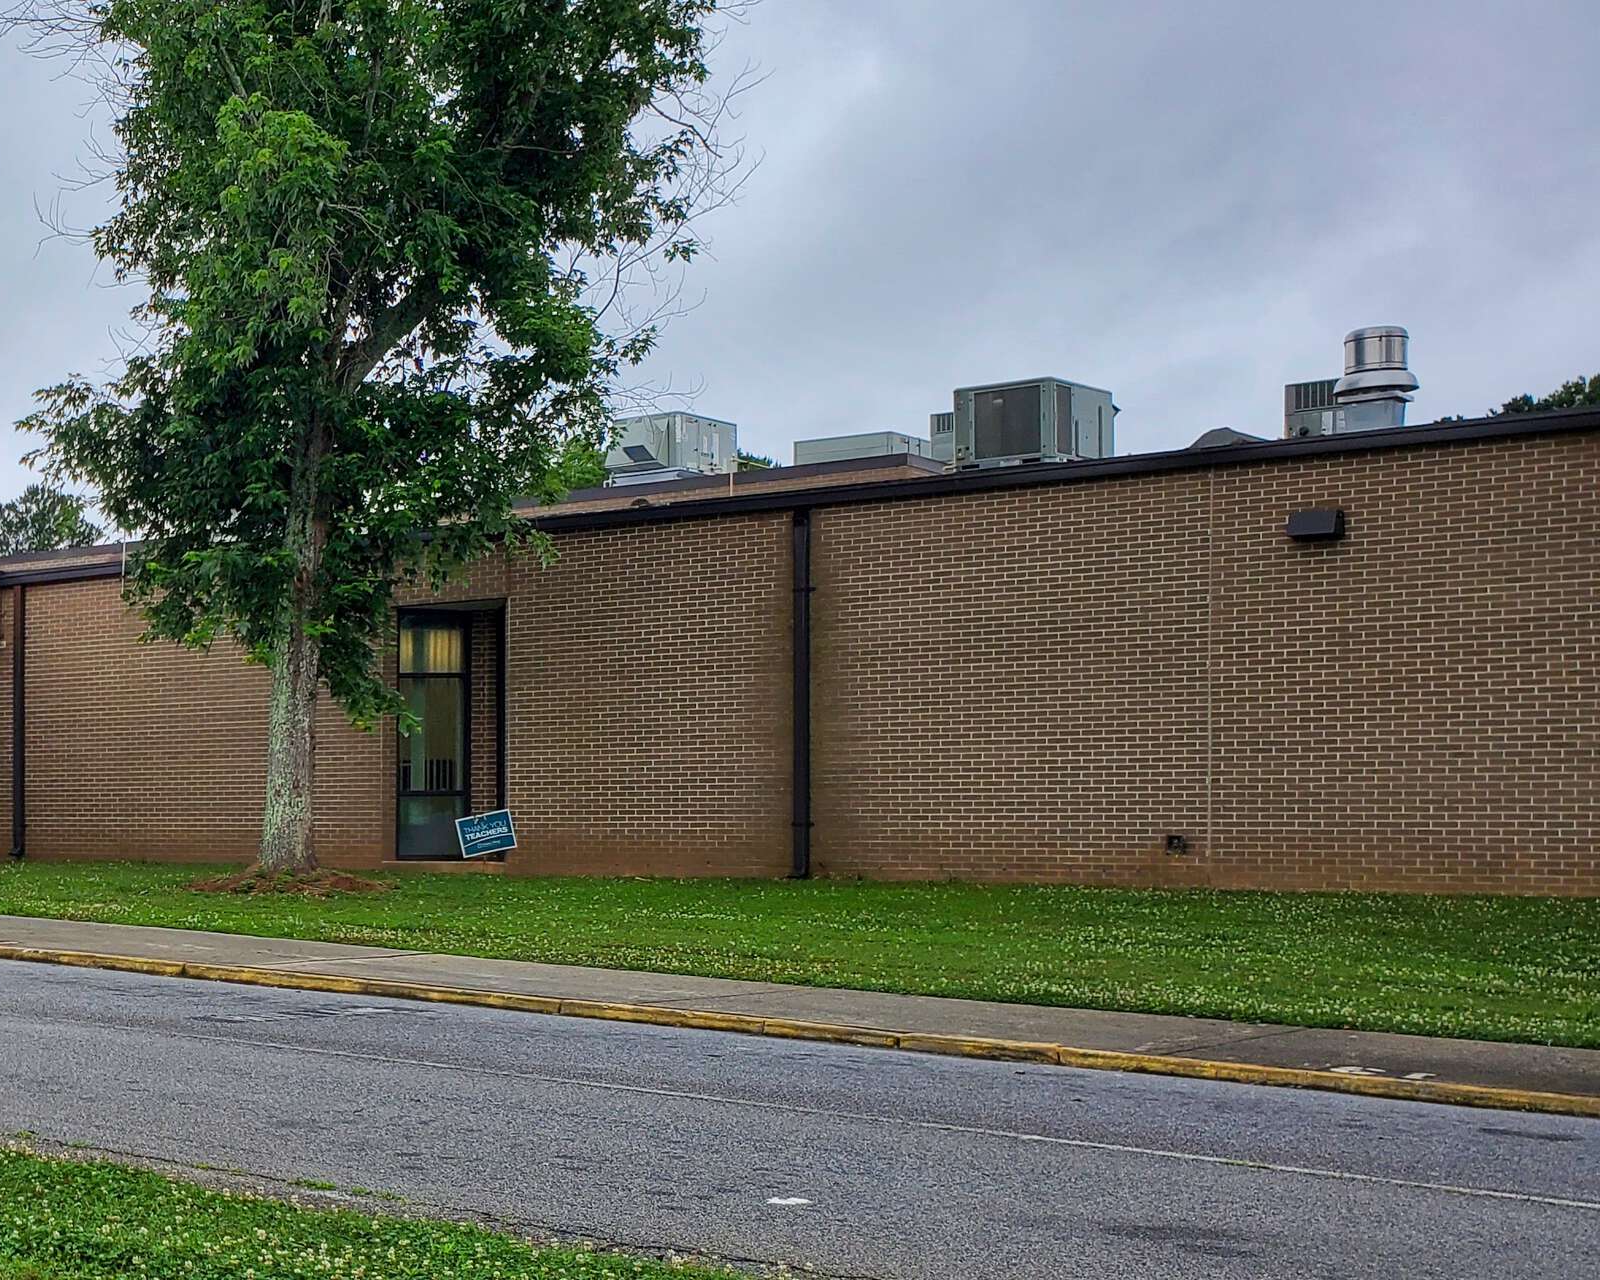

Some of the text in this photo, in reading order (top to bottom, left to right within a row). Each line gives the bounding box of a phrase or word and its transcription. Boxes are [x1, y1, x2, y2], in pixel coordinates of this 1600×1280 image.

[464, 820, 507, 834] THANK YOU
[465, 826, 508, 841] TEACHERS
